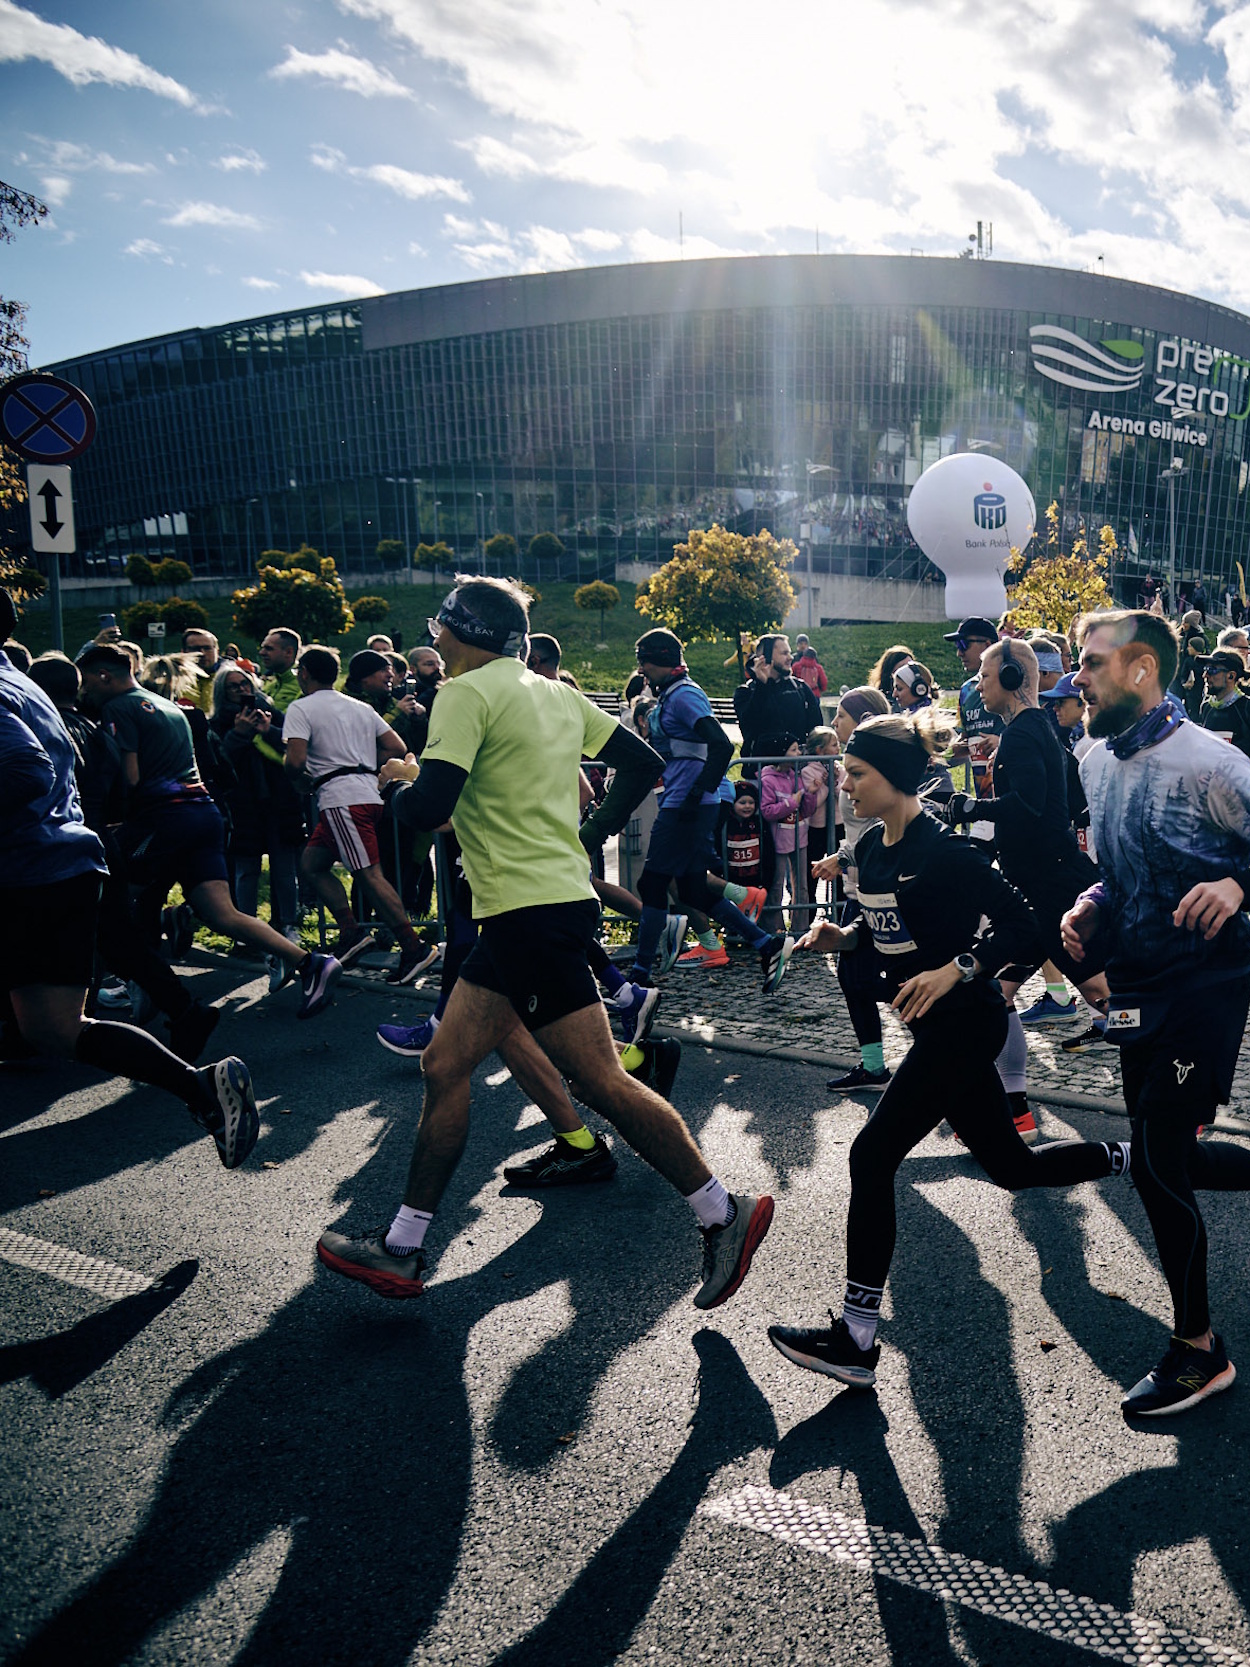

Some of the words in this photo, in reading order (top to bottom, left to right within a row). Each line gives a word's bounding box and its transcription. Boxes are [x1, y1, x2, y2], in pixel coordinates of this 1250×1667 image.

[1157, 340, 1214, 376] pre
[1154, 378, 1229, 417] zero
[1088, 410, 1145, 436] Arena
[1149, 420, 1208, 446] Gliwice
[966, 540, 987, 548] Bank
[733, 849, 753, 859] 315
